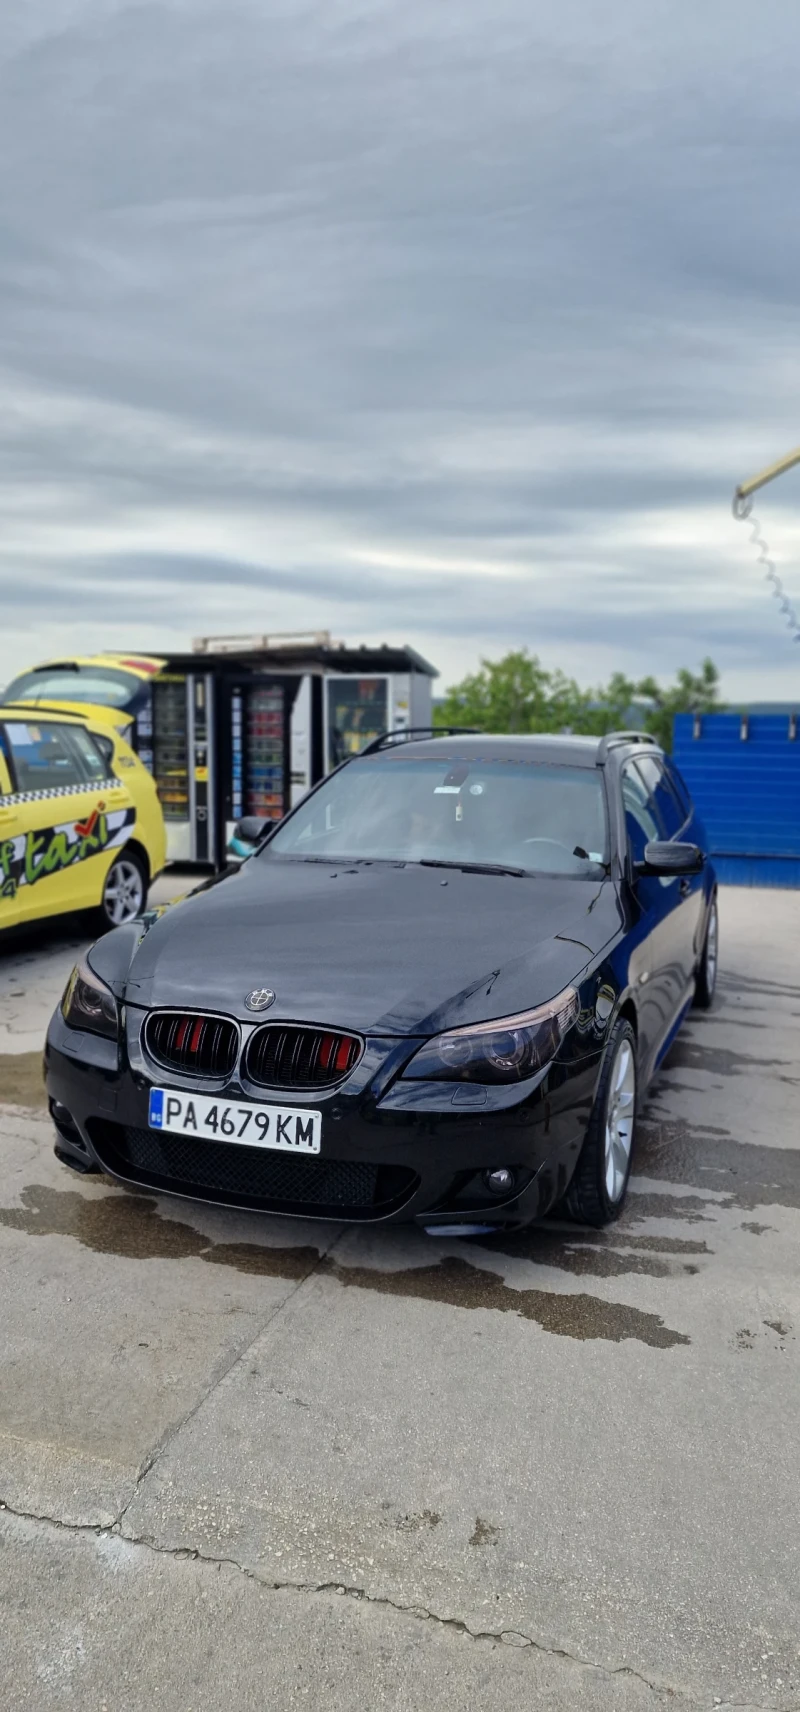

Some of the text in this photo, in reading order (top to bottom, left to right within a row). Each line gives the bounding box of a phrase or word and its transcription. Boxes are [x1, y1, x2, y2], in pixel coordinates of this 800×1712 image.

[25, 801, 107, 882] taxi
[166, 1097, 314, 1147] PA 4679 KM
